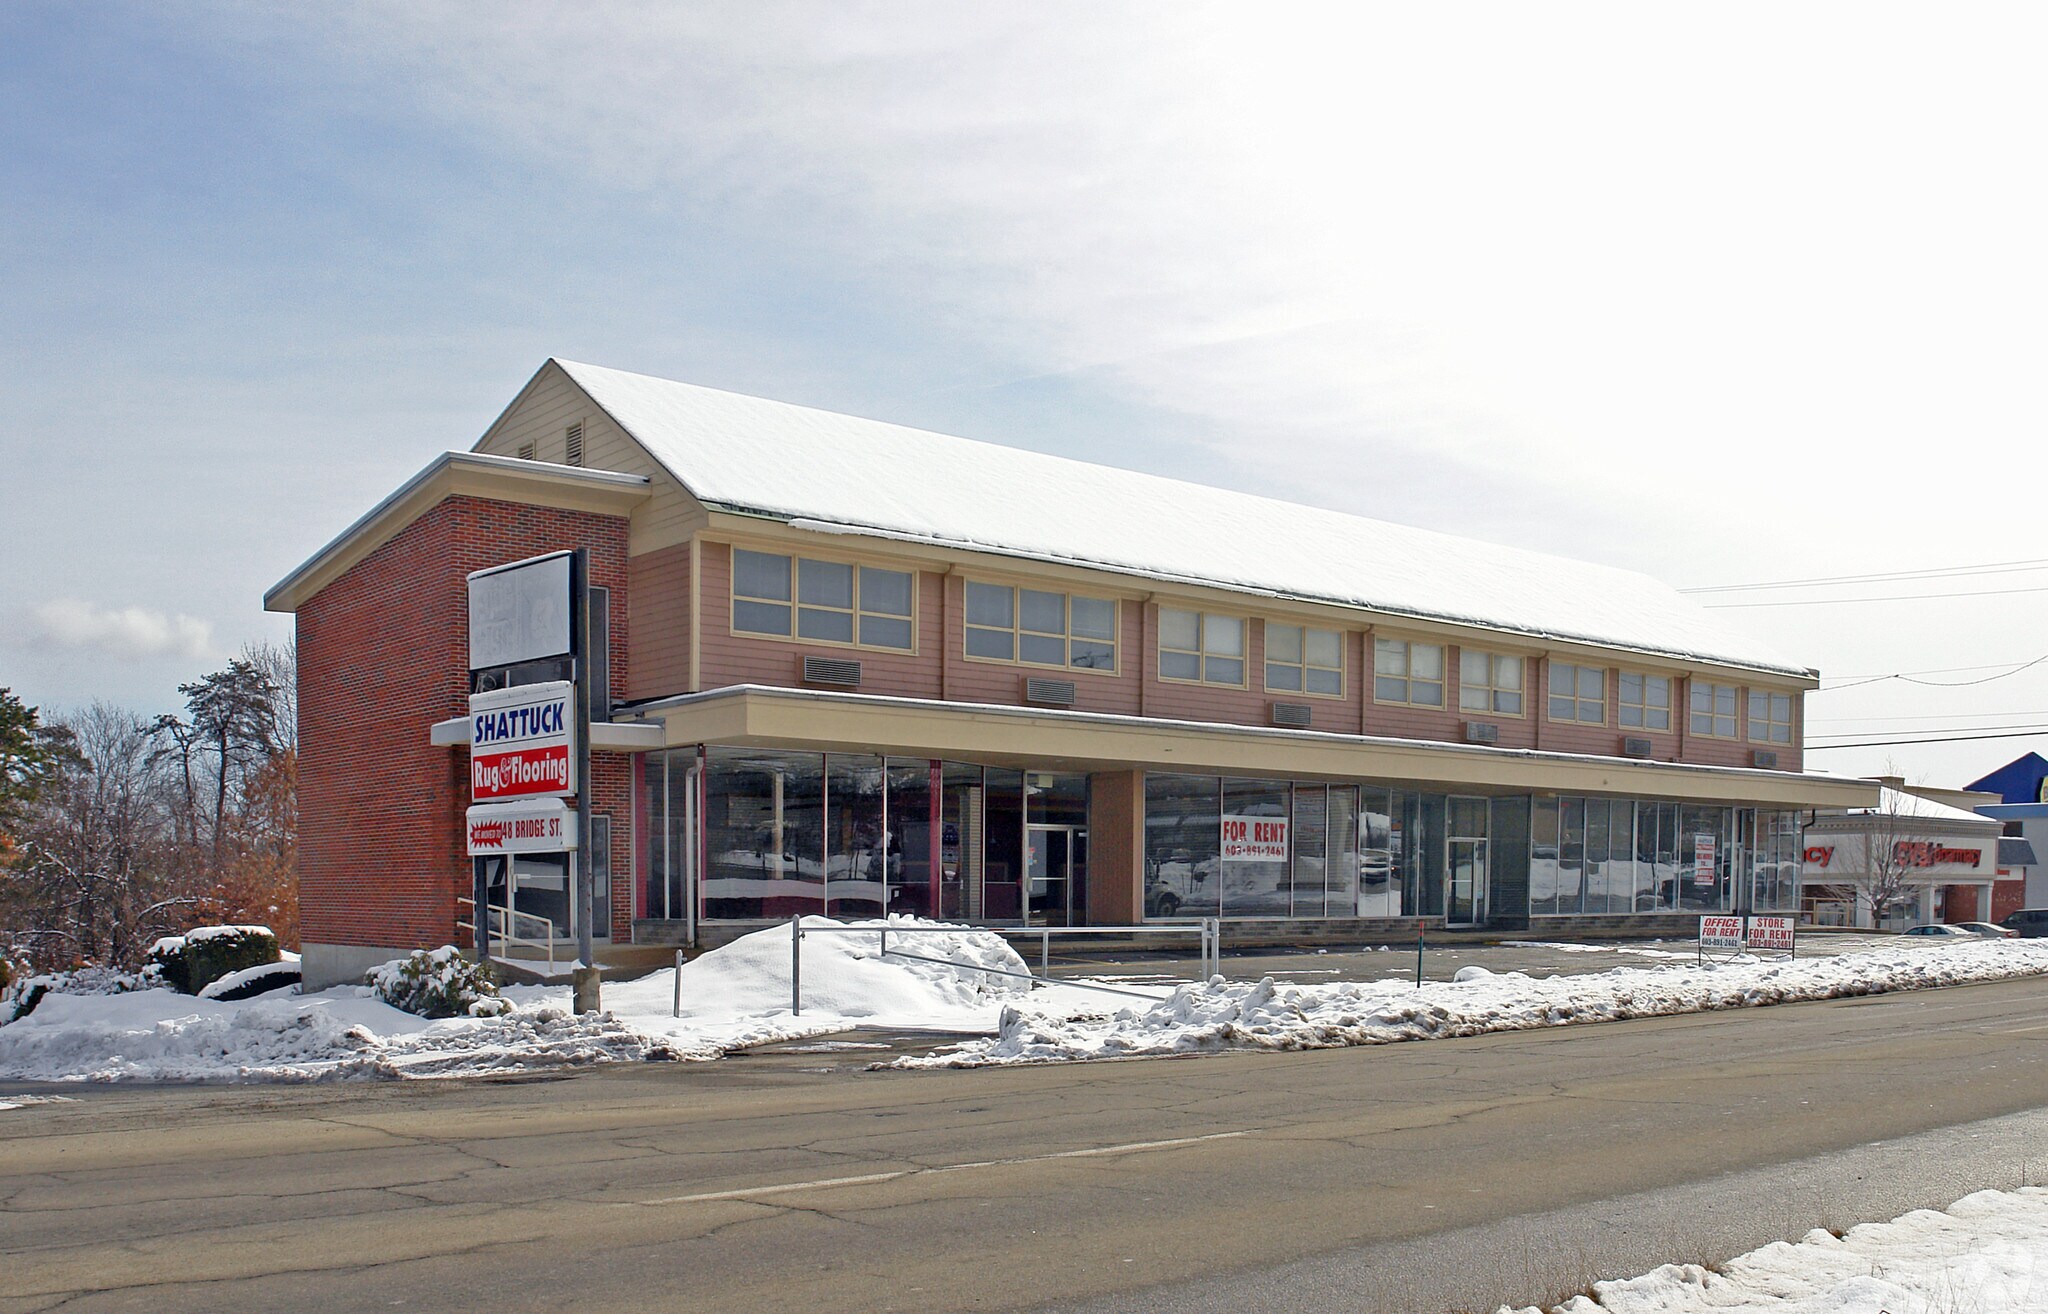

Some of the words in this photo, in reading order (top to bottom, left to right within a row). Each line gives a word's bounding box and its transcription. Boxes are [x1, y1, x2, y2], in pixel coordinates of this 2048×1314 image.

[475, 702, 564, 743] SHATTUCK
[511, 752, 567, 786] Flooring
[515, 819, 545, 839] BRIDGE
[549, 818, 563, 837] ST.
[1223, 821, 1247, 842] FOR
[1254, 822, 1286, 843] RENT
[1704, 917, 1740, 928] OFFICE
[1757, 917, 1785, 929] STORE
[1702, 927, 1718, 937] FOR
[1719, 928, 1741, 938] RENT
[1749, 929, 1766, 940] FOR
[1769, 930, 1793, 940] RENT
